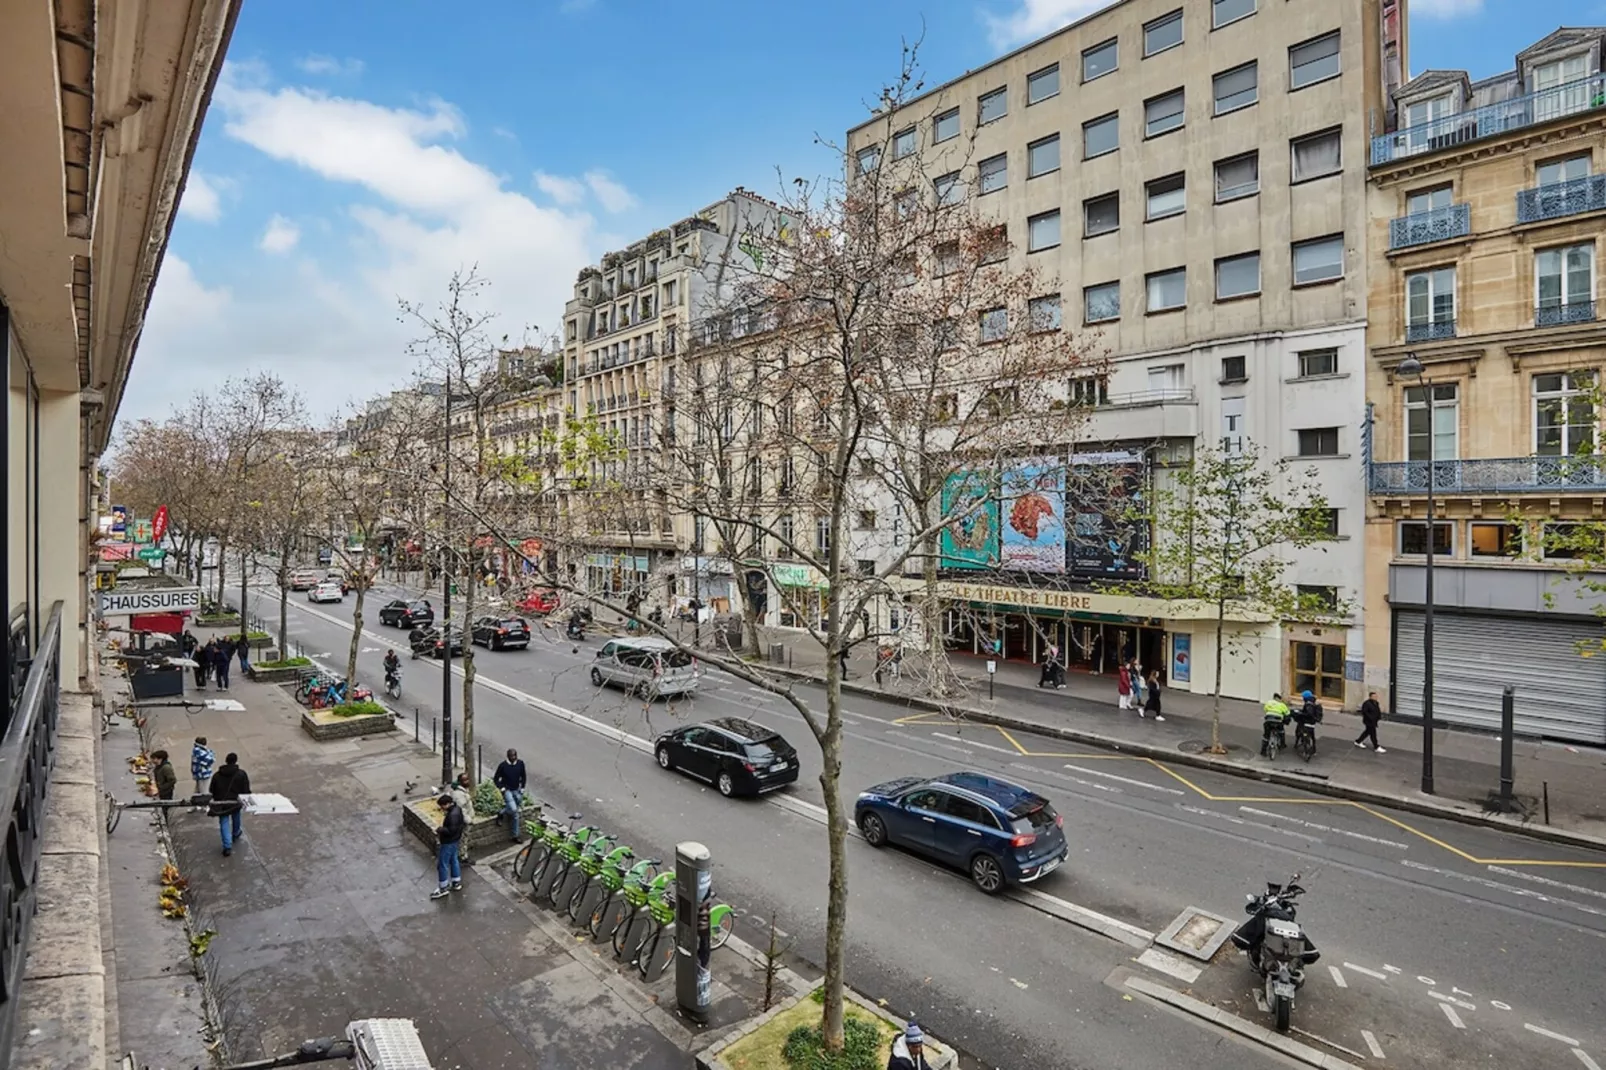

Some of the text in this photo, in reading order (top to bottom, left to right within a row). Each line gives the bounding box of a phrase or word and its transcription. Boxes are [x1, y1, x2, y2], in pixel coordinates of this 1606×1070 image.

[102, 592, 199, 610] CHAUSSURES
[955, 585, 971, 599] LE
[1044, 592, 1092, 609] LIBRE
